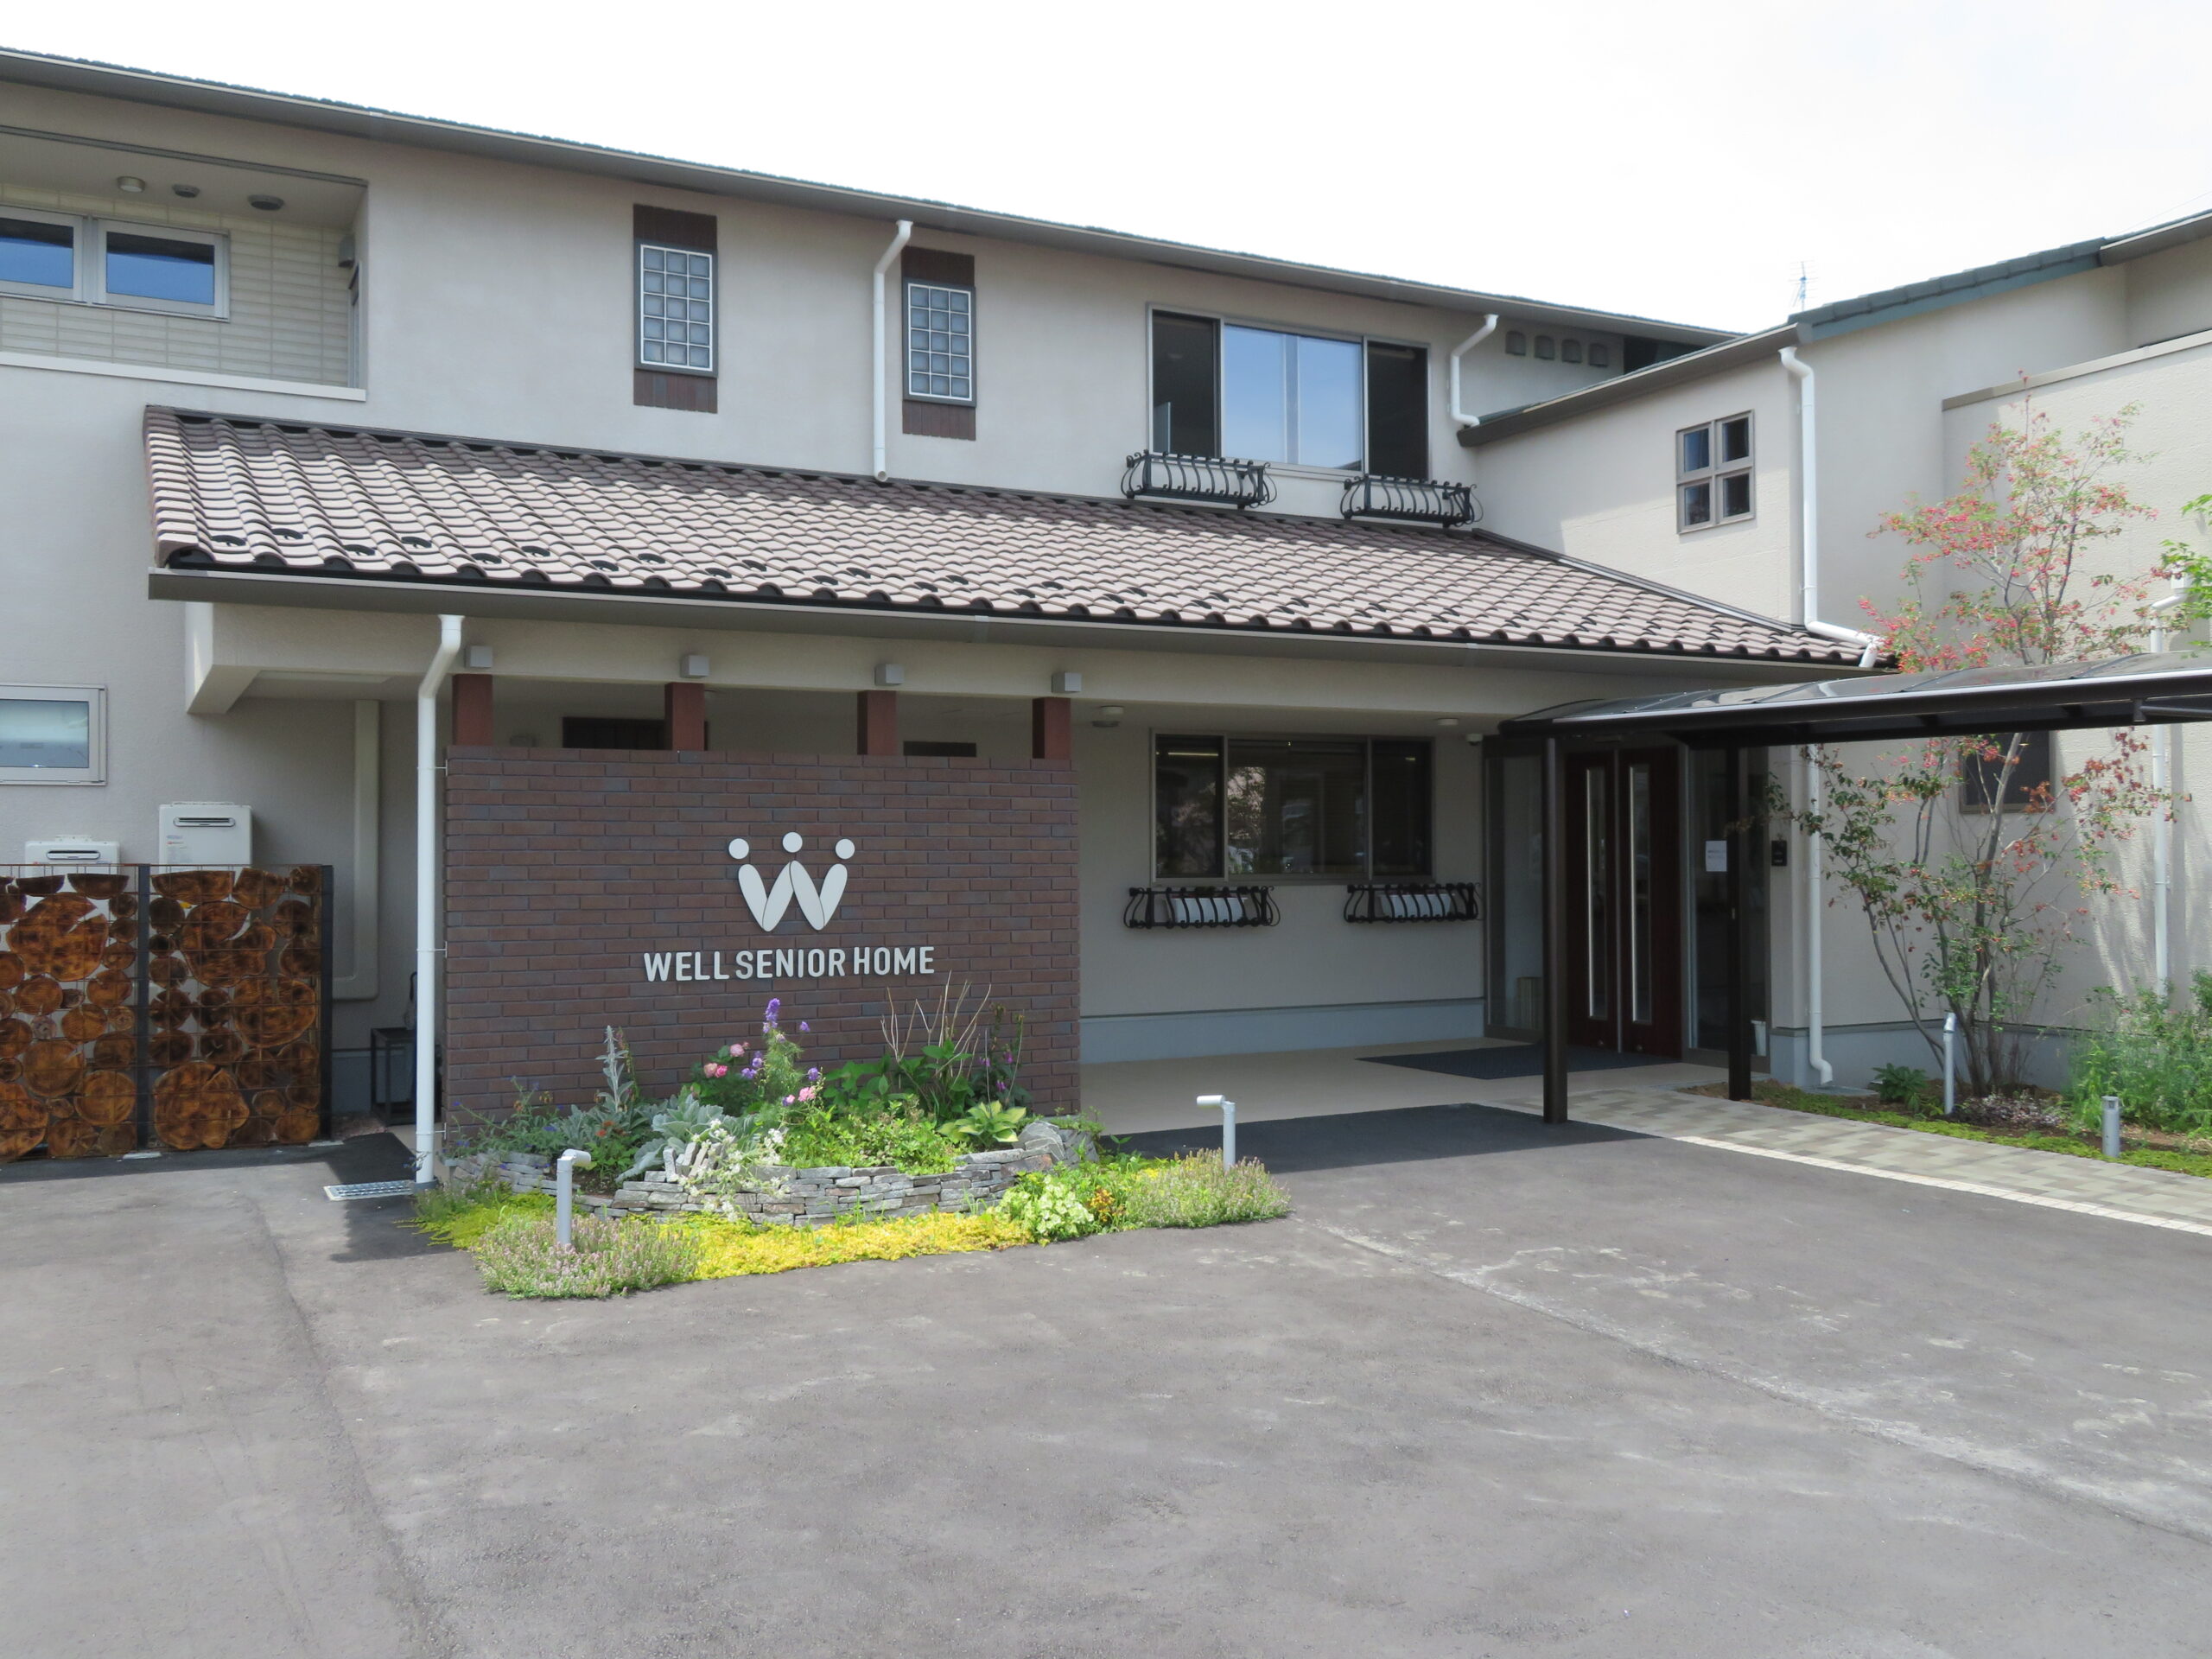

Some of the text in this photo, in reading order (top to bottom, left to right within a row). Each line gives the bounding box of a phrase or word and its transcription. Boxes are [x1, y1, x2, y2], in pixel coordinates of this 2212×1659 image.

[643, 946, 935, 982] WELL SENIOR HOME
